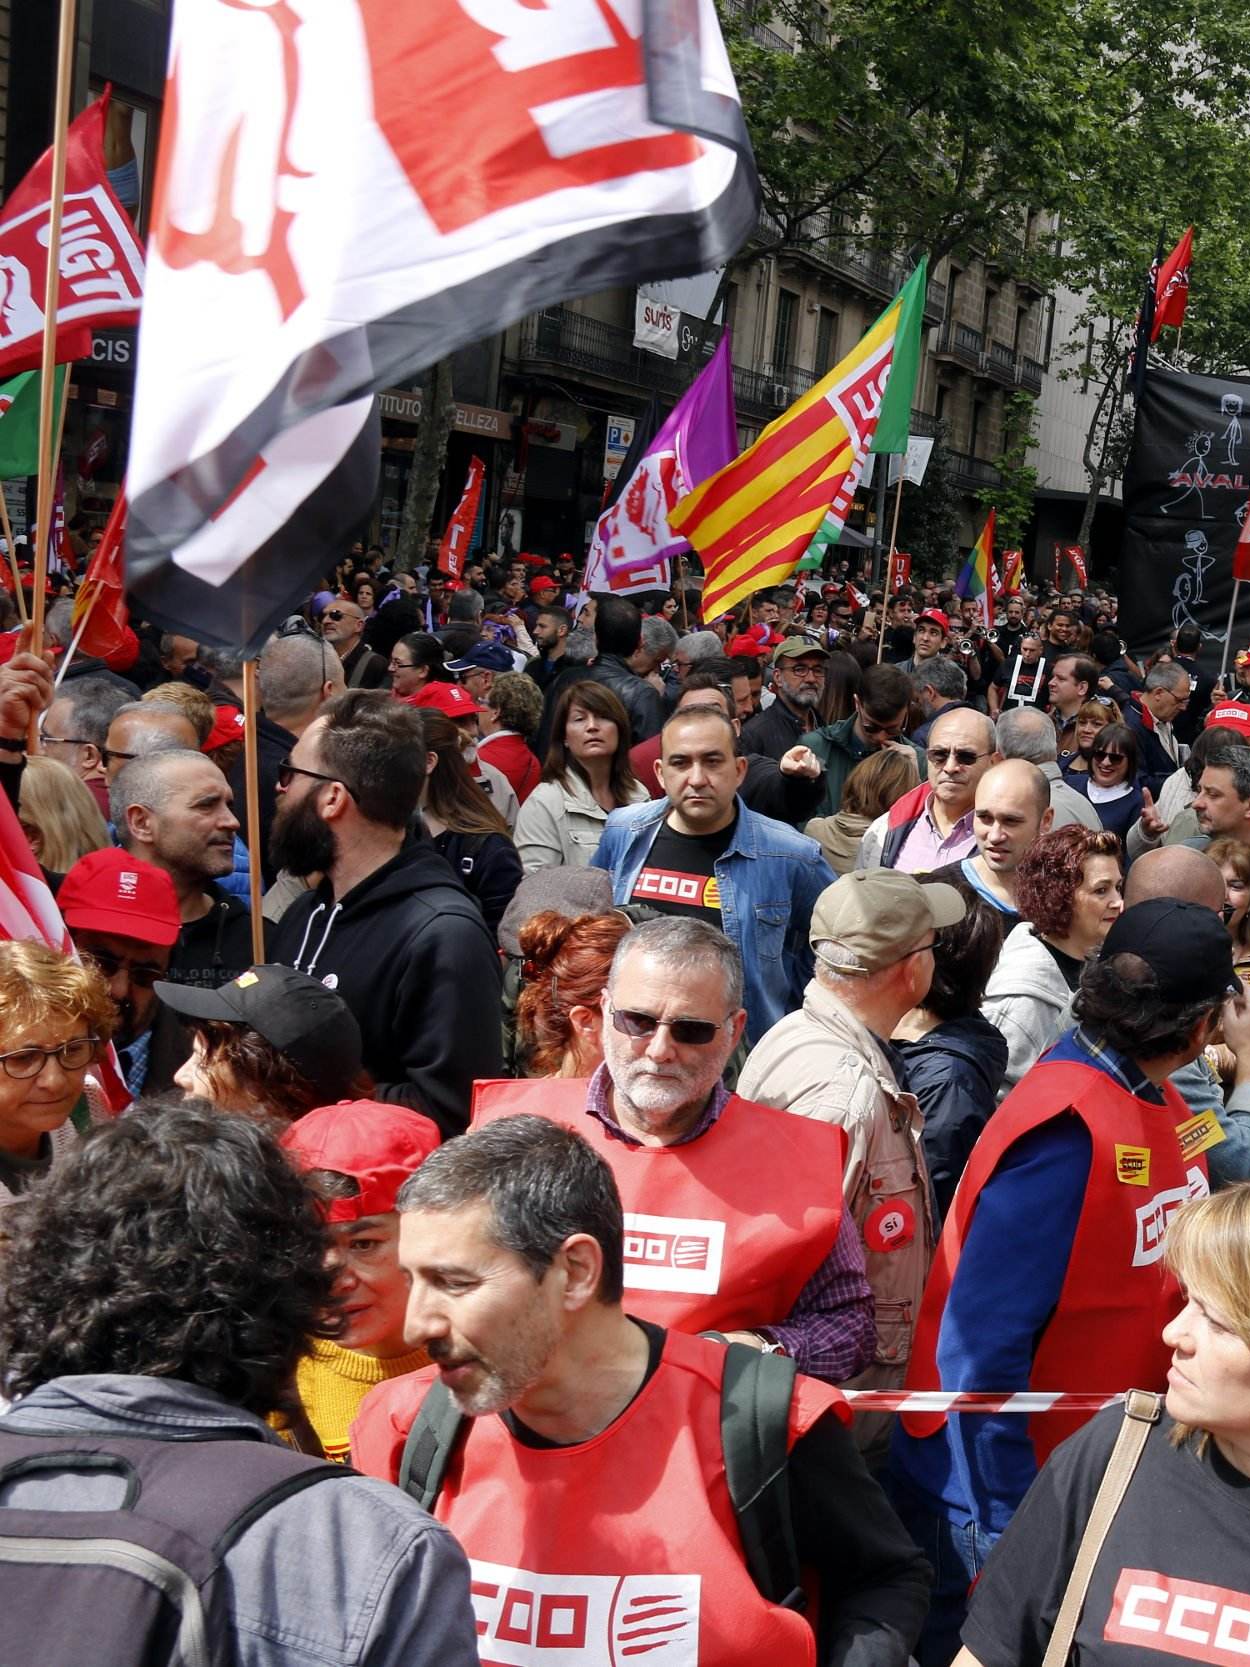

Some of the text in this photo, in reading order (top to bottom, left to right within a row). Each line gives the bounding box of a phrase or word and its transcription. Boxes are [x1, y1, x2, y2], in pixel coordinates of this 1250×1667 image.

[36, 209, 134, 300] UGT
[643, 304, 673, 332] suris
[610, 427, 619, 443] P
